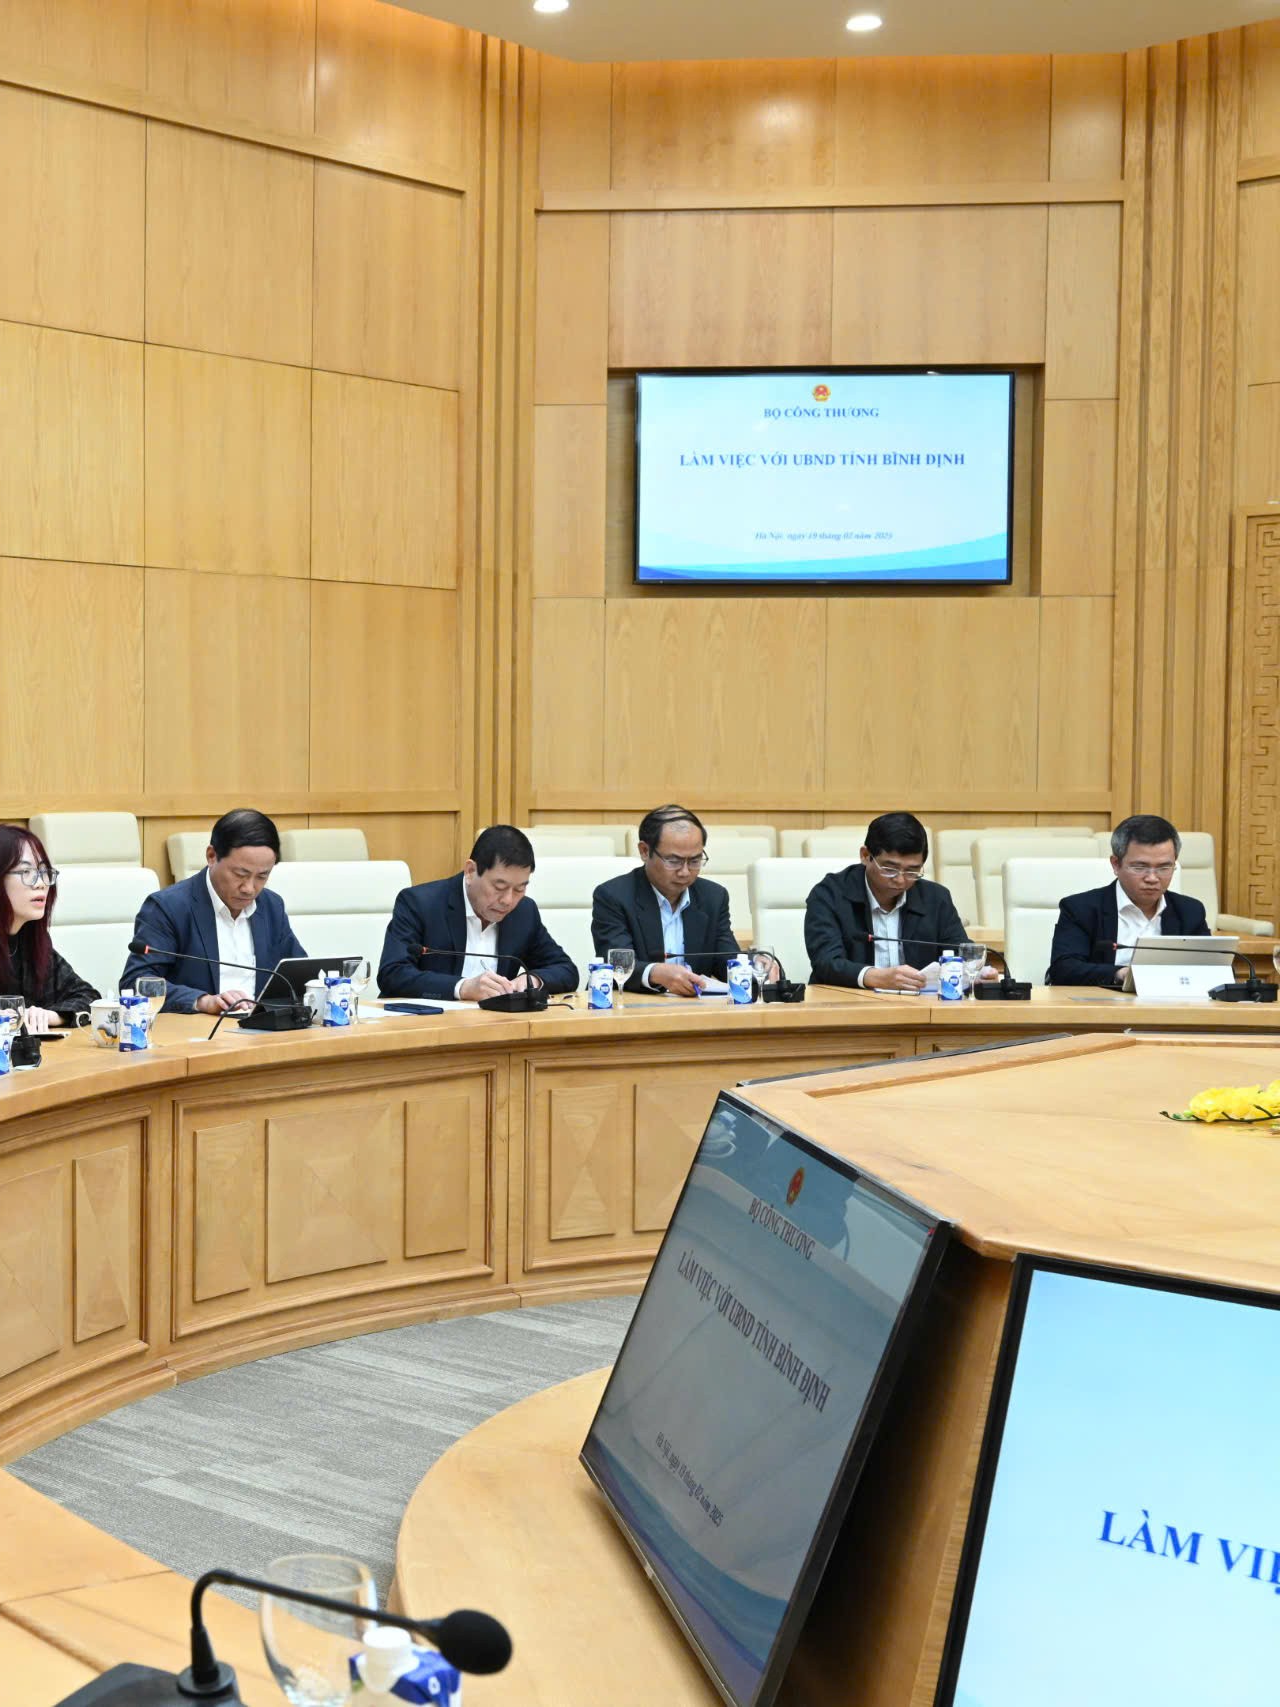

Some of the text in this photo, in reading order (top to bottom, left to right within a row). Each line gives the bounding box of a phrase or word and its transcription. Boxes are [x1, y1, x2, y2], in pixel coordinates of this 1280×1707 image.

[764, 406, 879, 420] BỘ CÔNG THƯƠNG
[680, 451, 714, 466] LÀM
[719, 452, 756, 468] VIỆC
[760, 451, 787, 466] VỚI
[793, 453, 835, 466] UBND
[926, 453, 965, 468] ĐỊNH
[759, 1204, 785, 1236] CÔNG
[696, 1267, 717, 1301] VIỆC
[728, 1299, 755, 1338] UBND
[799, 1367, 831, 1413] ĐỊNH
[1096, 1509, 1204, 1565] LÀM
